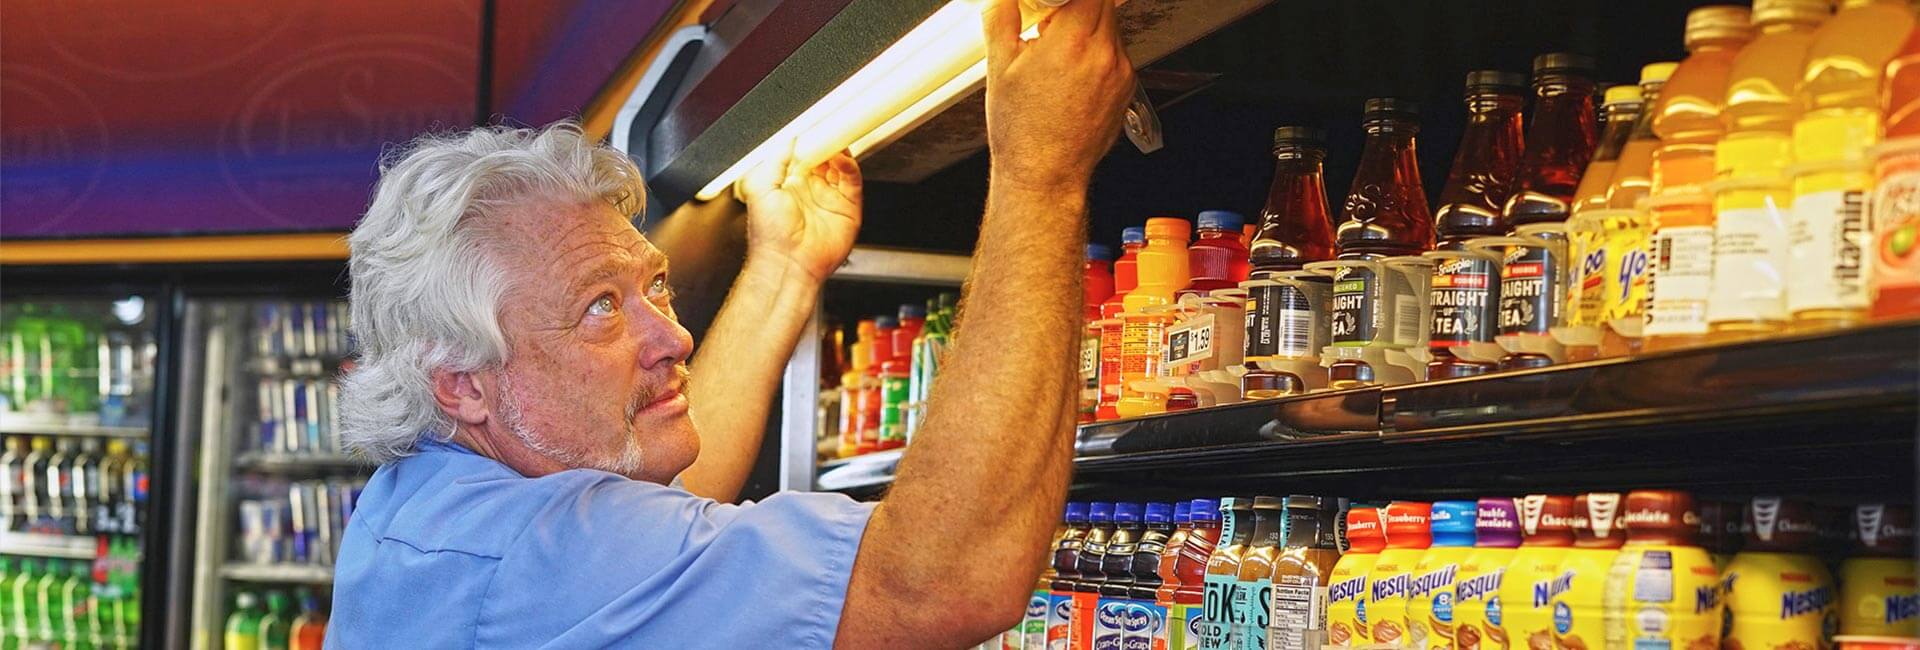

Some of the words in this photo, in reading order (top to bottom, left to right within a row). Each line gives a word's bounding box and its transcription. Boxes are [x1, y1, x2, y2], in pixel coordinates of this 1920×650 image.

[1834, 190, 1863, 298] vitamin
[1435, 317, 1464, 335] TEA
[1190, 327, 1210, 352] $1.59
